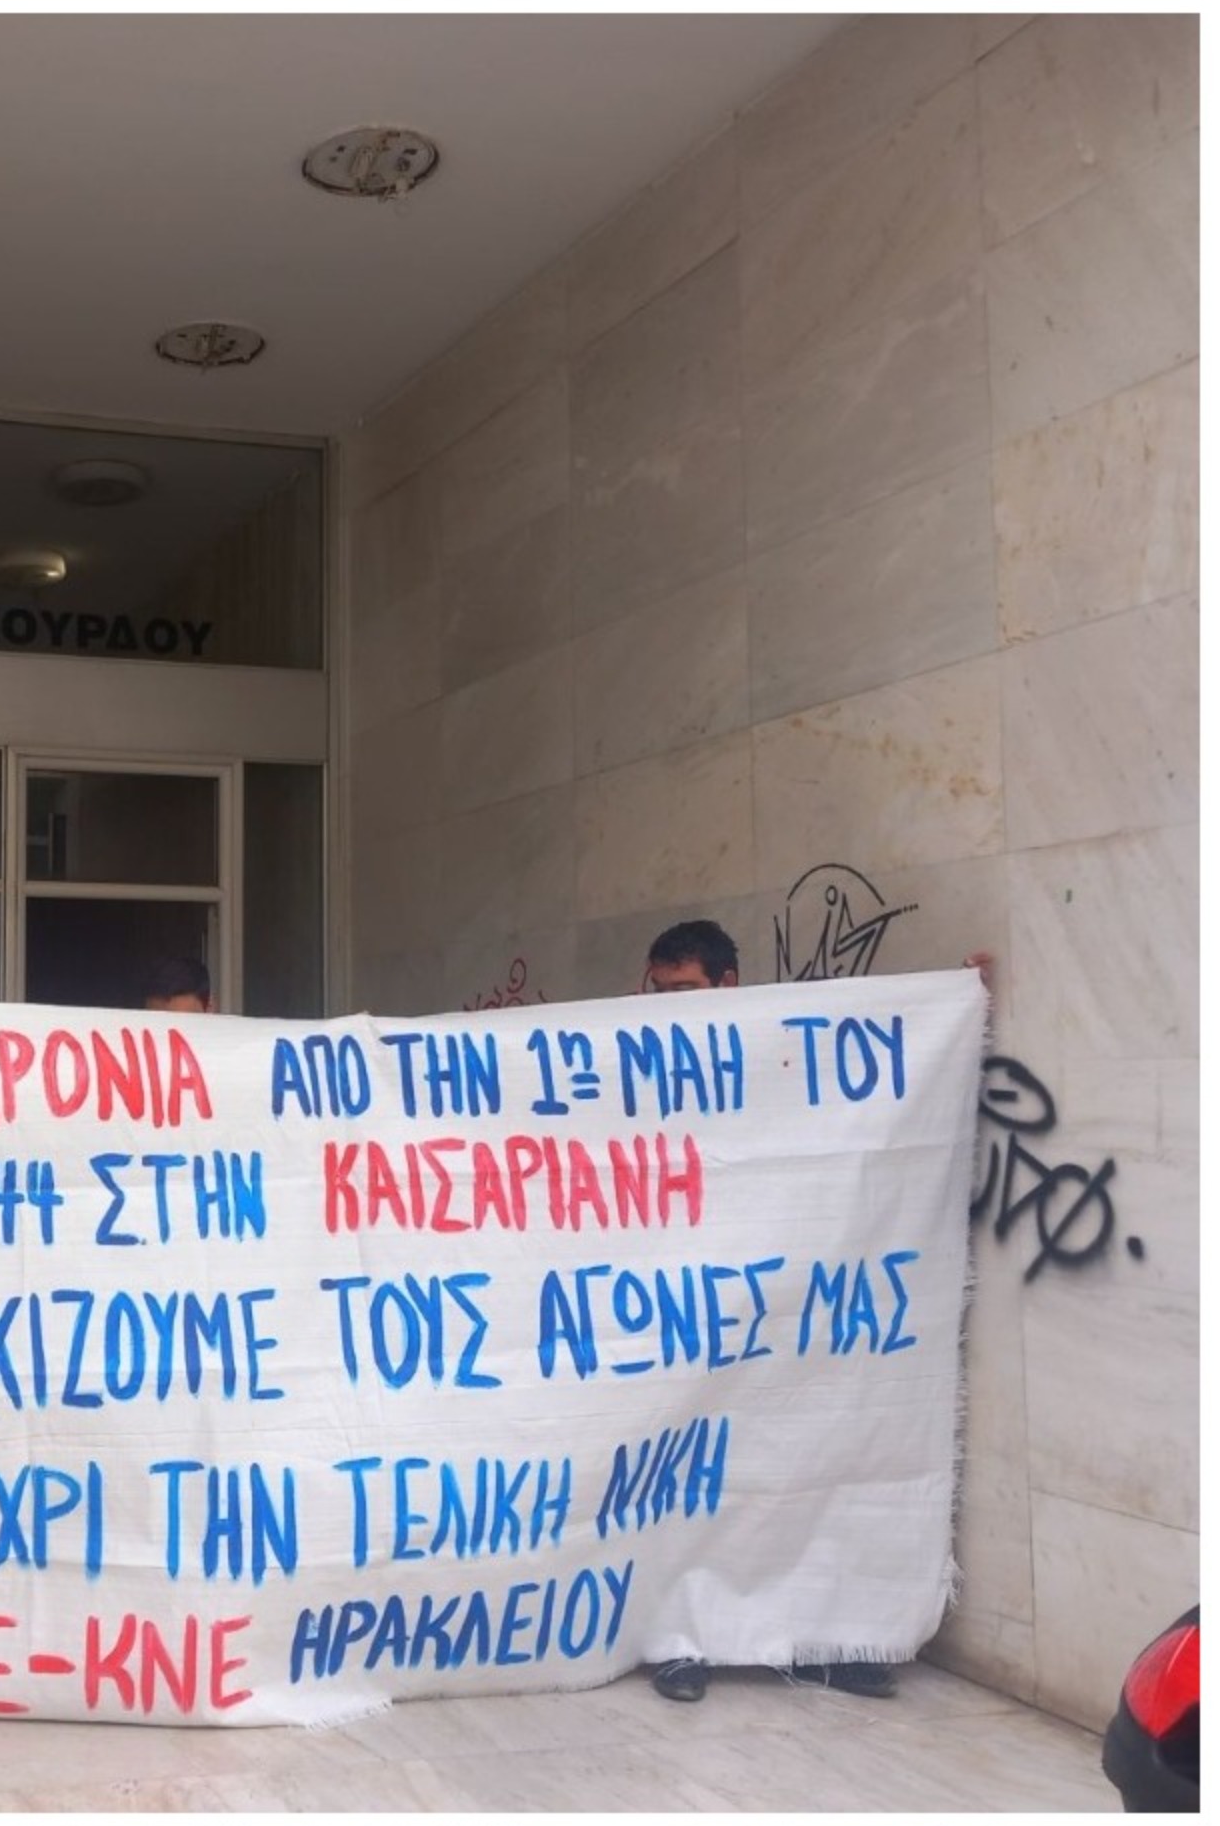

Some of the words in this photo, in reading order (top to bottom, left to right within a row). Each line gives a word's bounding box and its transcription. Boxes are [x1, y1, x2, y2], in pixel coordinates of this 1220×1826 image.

[272, 1033, 370, 1121] ΑΠΟ
[381, 1032, 500, 1118] ΤΗΝ
[616, 1022, 743, 1120] ΜΑΗ
[782, 1015, 905, 1106] ΤΟΥ
[90, 1150, 266, 1247] ΣΤΗΝ
[324, 1132, 703, 1233] ΚΑΙΣΑΡΙΑΝΗ
[321, 1273, 501, 1390] ΤΟΥΣ
[540, 1258, 784, 1380] ΑΓΩΝΕΣ
[798, 1251, 919, 1356] ΜΑΣ
[149, 1460, 298, 1586] ΤΗΝ
[334, 1455, 572, 1568] ΤΕΛΙΚΗ
[596, 1415, 729, 1540] ΝΙΚΗ
[289, 1559, 633, 1685] ΗΡΑΚΛΕΙΟΥ
